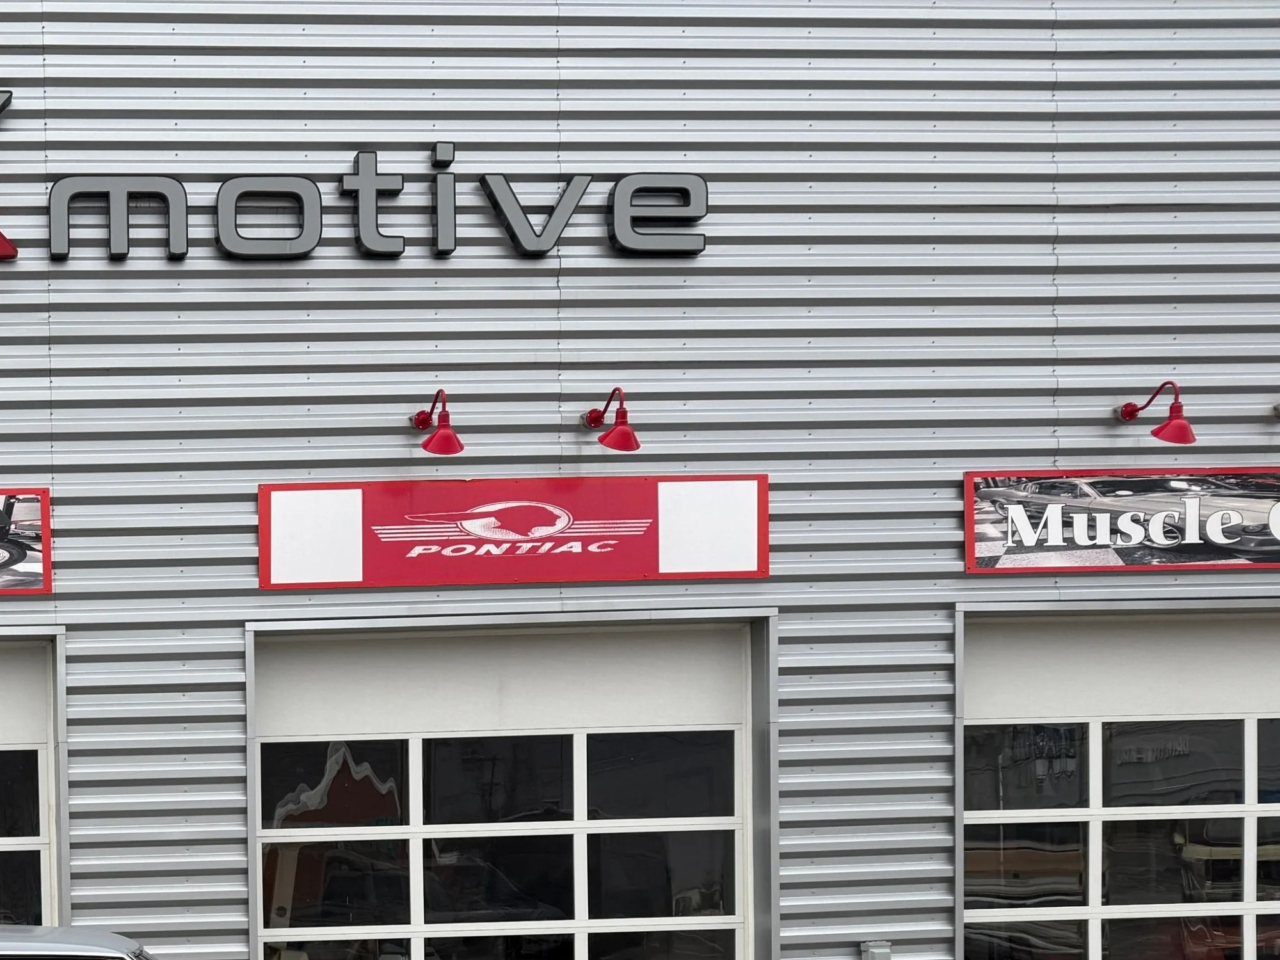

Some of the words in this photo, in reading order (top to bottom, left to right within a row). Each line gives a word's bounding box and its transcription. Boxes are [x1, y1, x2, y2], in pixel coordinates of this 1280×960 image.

[47, 140, 710, 262] motive
[1002, 496, 1244, 548] Muscle
[405, 539, 619, 558] PONTIAC
